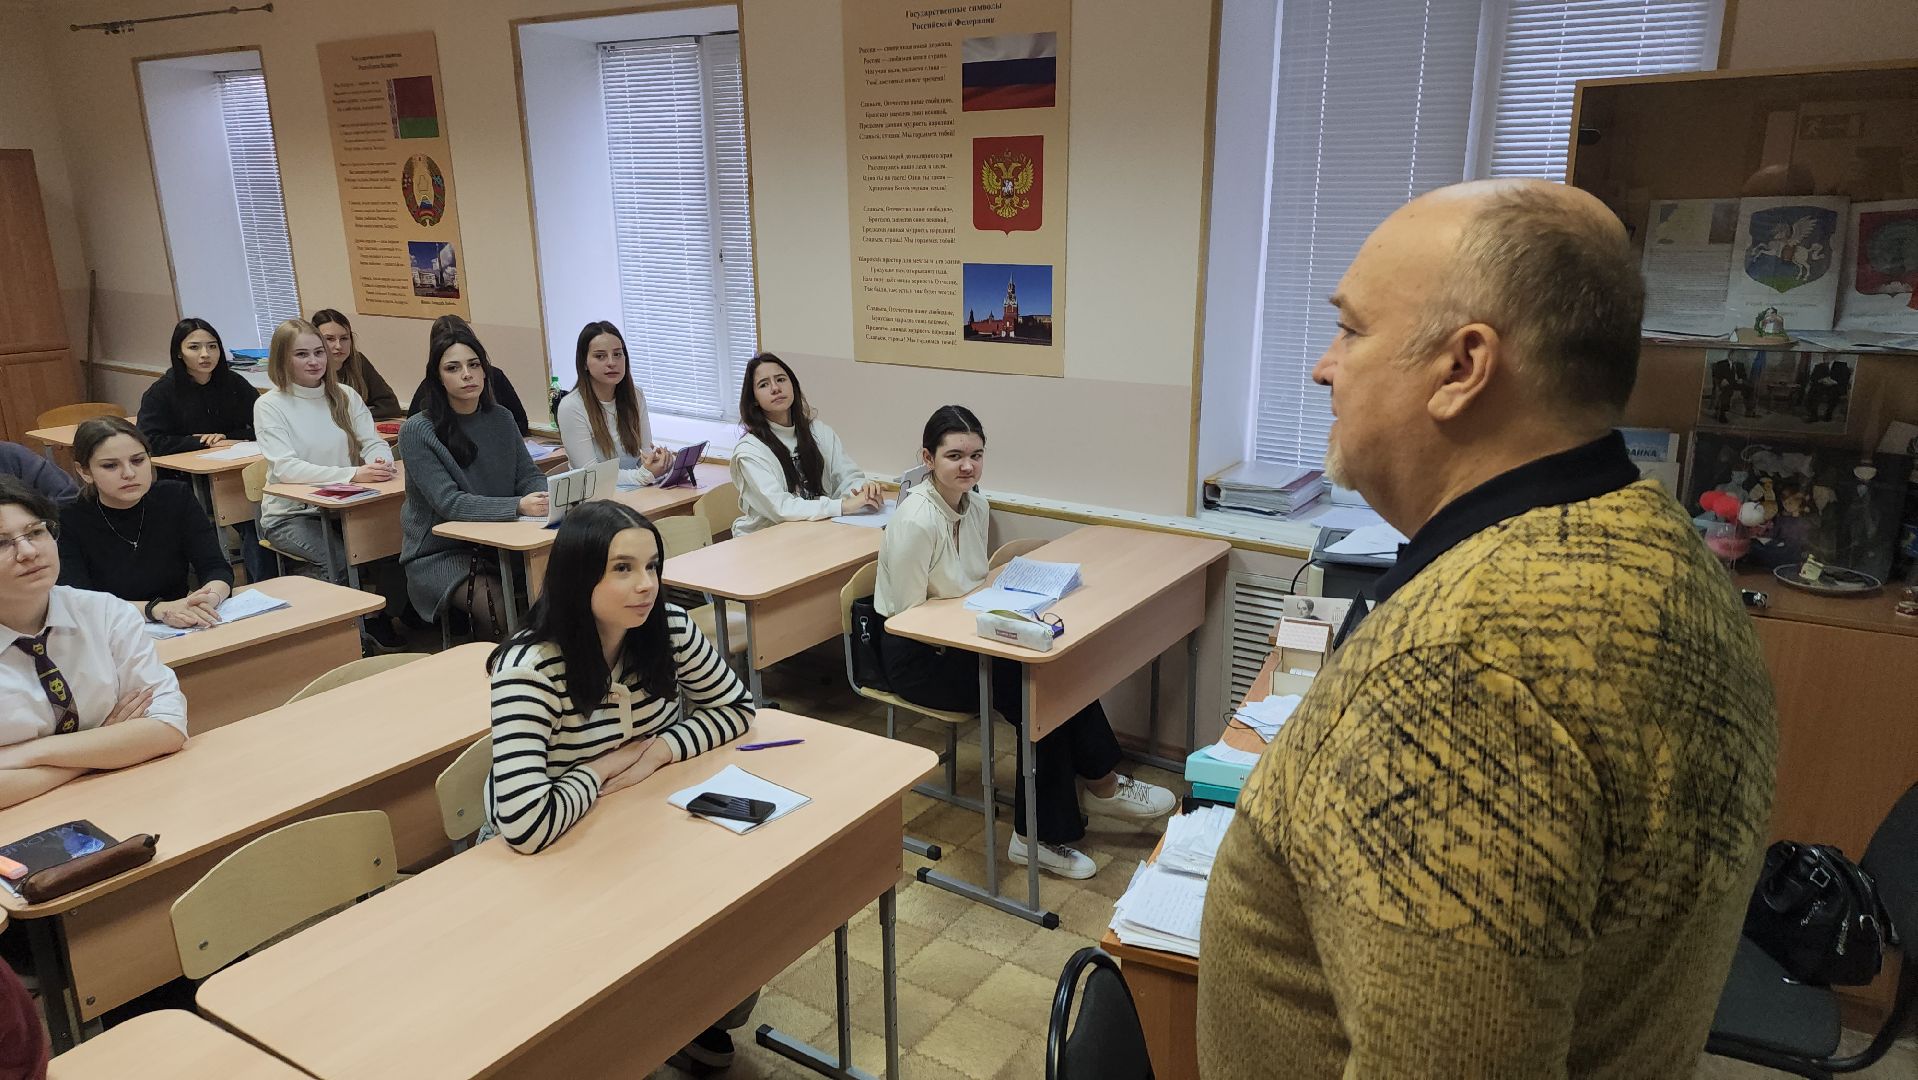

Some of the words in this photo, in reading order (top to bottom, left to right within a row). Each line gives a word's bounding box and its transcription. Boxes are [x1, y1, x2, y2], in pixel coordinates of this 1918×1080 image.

[905, 7, 967, 19] Государственные
[968, 2, 1002, 12] символы
[912, 19, 953, 30] Российской
